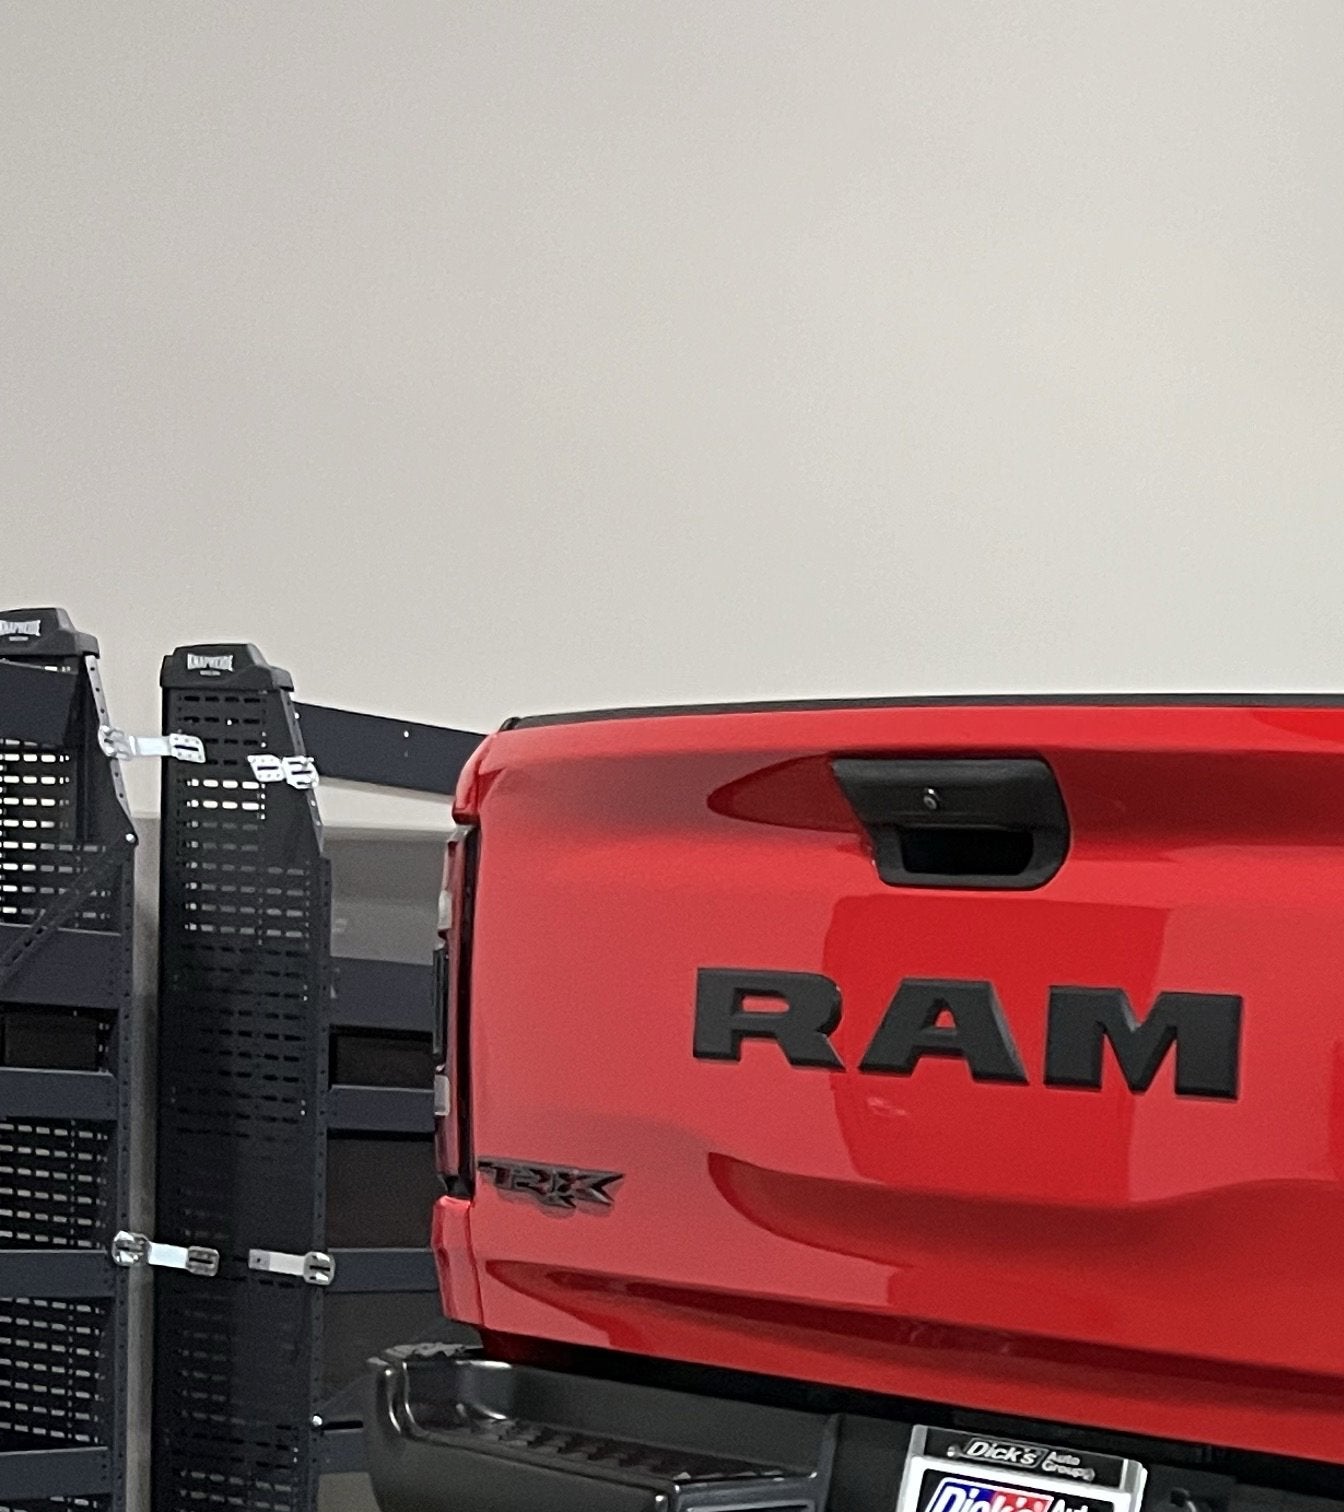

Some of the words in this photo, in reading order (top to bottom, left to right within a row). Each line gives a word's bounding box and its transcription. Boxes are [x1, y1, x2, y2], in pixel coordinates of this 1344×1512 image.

[692, 967, 1242, 1102] RAM
[477, 1157, 625, 1209] TRX
[967, 1440, 1038, 1465] Dick's
